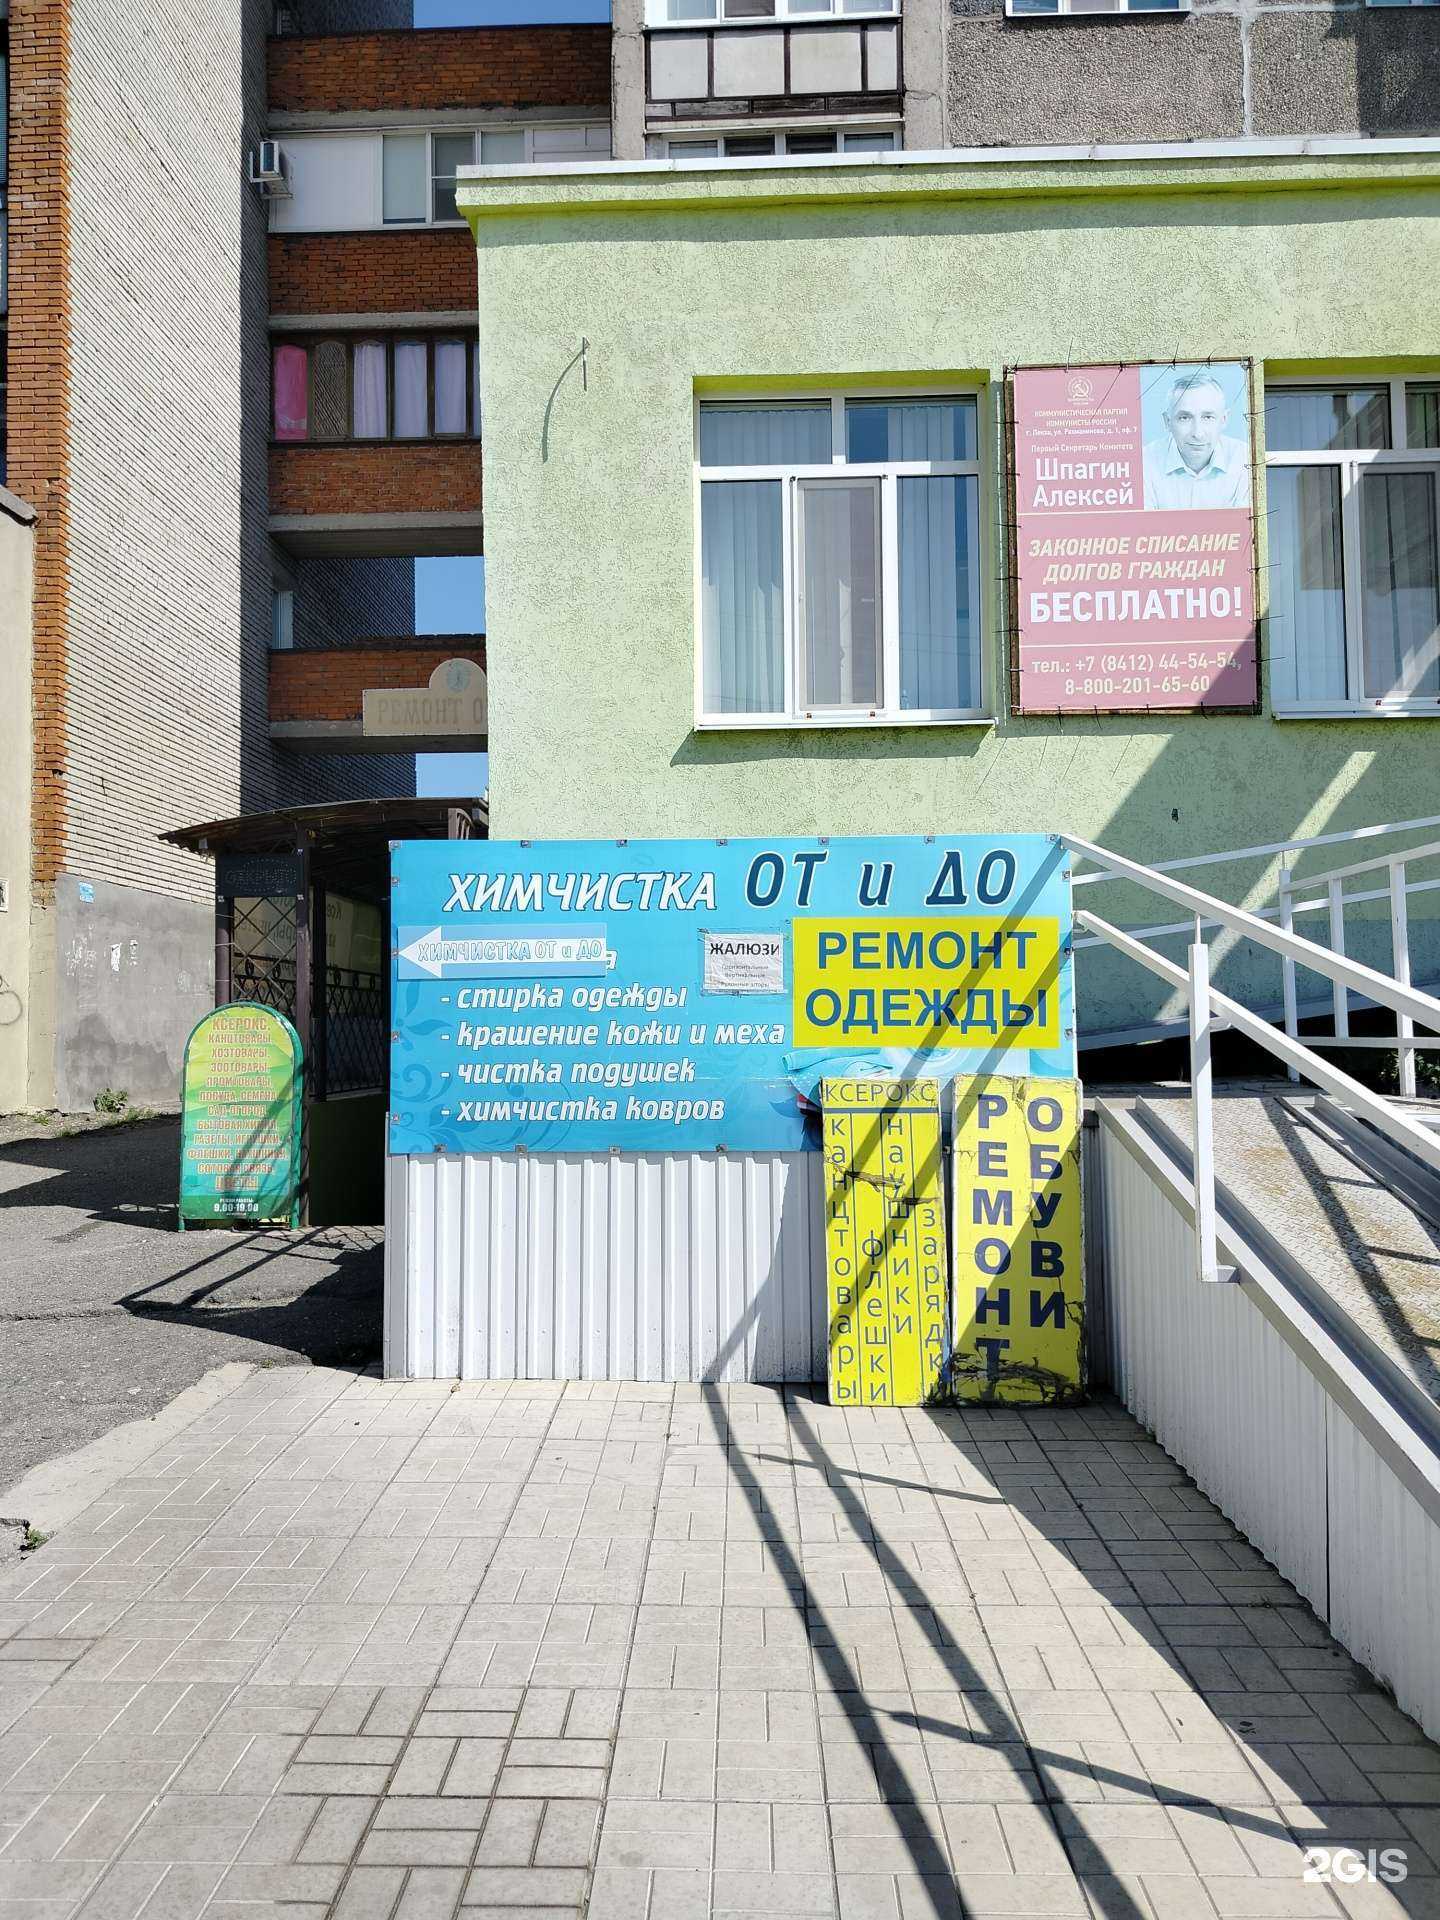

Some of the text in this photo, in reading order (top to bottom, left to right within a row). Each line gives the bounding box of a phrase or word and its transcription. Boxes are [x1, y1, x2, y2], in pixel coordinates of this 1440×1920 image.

[1031, 442, 1133, 454] Первый Секретарь Комитета
[1035, 458, 1130, 482] Шпагин
[1032, 482, 1133, 507] Алексей
[1029, 533, 1240, 558] ЗАКОННОЕ СПИСАНИЕ
[1043, 558, 1225, 585] ДОЛГОВ ГРАЖДАН
[1030, 586, 1242, 624] БЕСПЛАТНО!
[1032, 658, 1071, 674] тел.:
[1075, 656, 1095, 673] +7
[1101, 653, 1155, 675] (8412)
[1065, 676, 1210, 695] 8-800-201-65-60
[377, 697, 463, 725] РЕМОНТ
[442, 849, 1018, 912] ХИМЧИСТКА ОТ и ДО
[418, 942, 531, 962] ХИМЧИСТКА
[535, 941, 556, 959] ОТ
[561, 946, 572, 959] и
[575, 940, 602, 961] ДО
[710, 943, 780, 955] ЖАЛЮЗИ
[818, 931, 1038, 969] РЕМОНТ
[457, 983, 564, 1013] стирка
[571, 983, 688, 1013] одежды
[805, 988, 1047, 1035] ОДЕЖДЫ
[212, 1017, 271, 1031] КСЕРОКС.
[457, 1021, 599, 1051] крашение
[607, 1020, 681, 1046] кожи
[689, 1023, 708, 1045] и
[714, 1023, 785, 1045] меха
[457, 1058, 562, 1085] чистка
[570, 1057, 697, 1088] подушек
[825, 1083, 934, 1103] КСЕРОКС
[457, 1098, 617, 1122] химчистка
[625, 1097, 725, 1125] ковров
[1026, 1096, 1066, 1330] ОБУВИ
[831, 1116, 857, 1400] канцтовары
[972, 1094, 1013, 1401] РЕМОНТ
[862, 1229, 888, 1402] флешки
